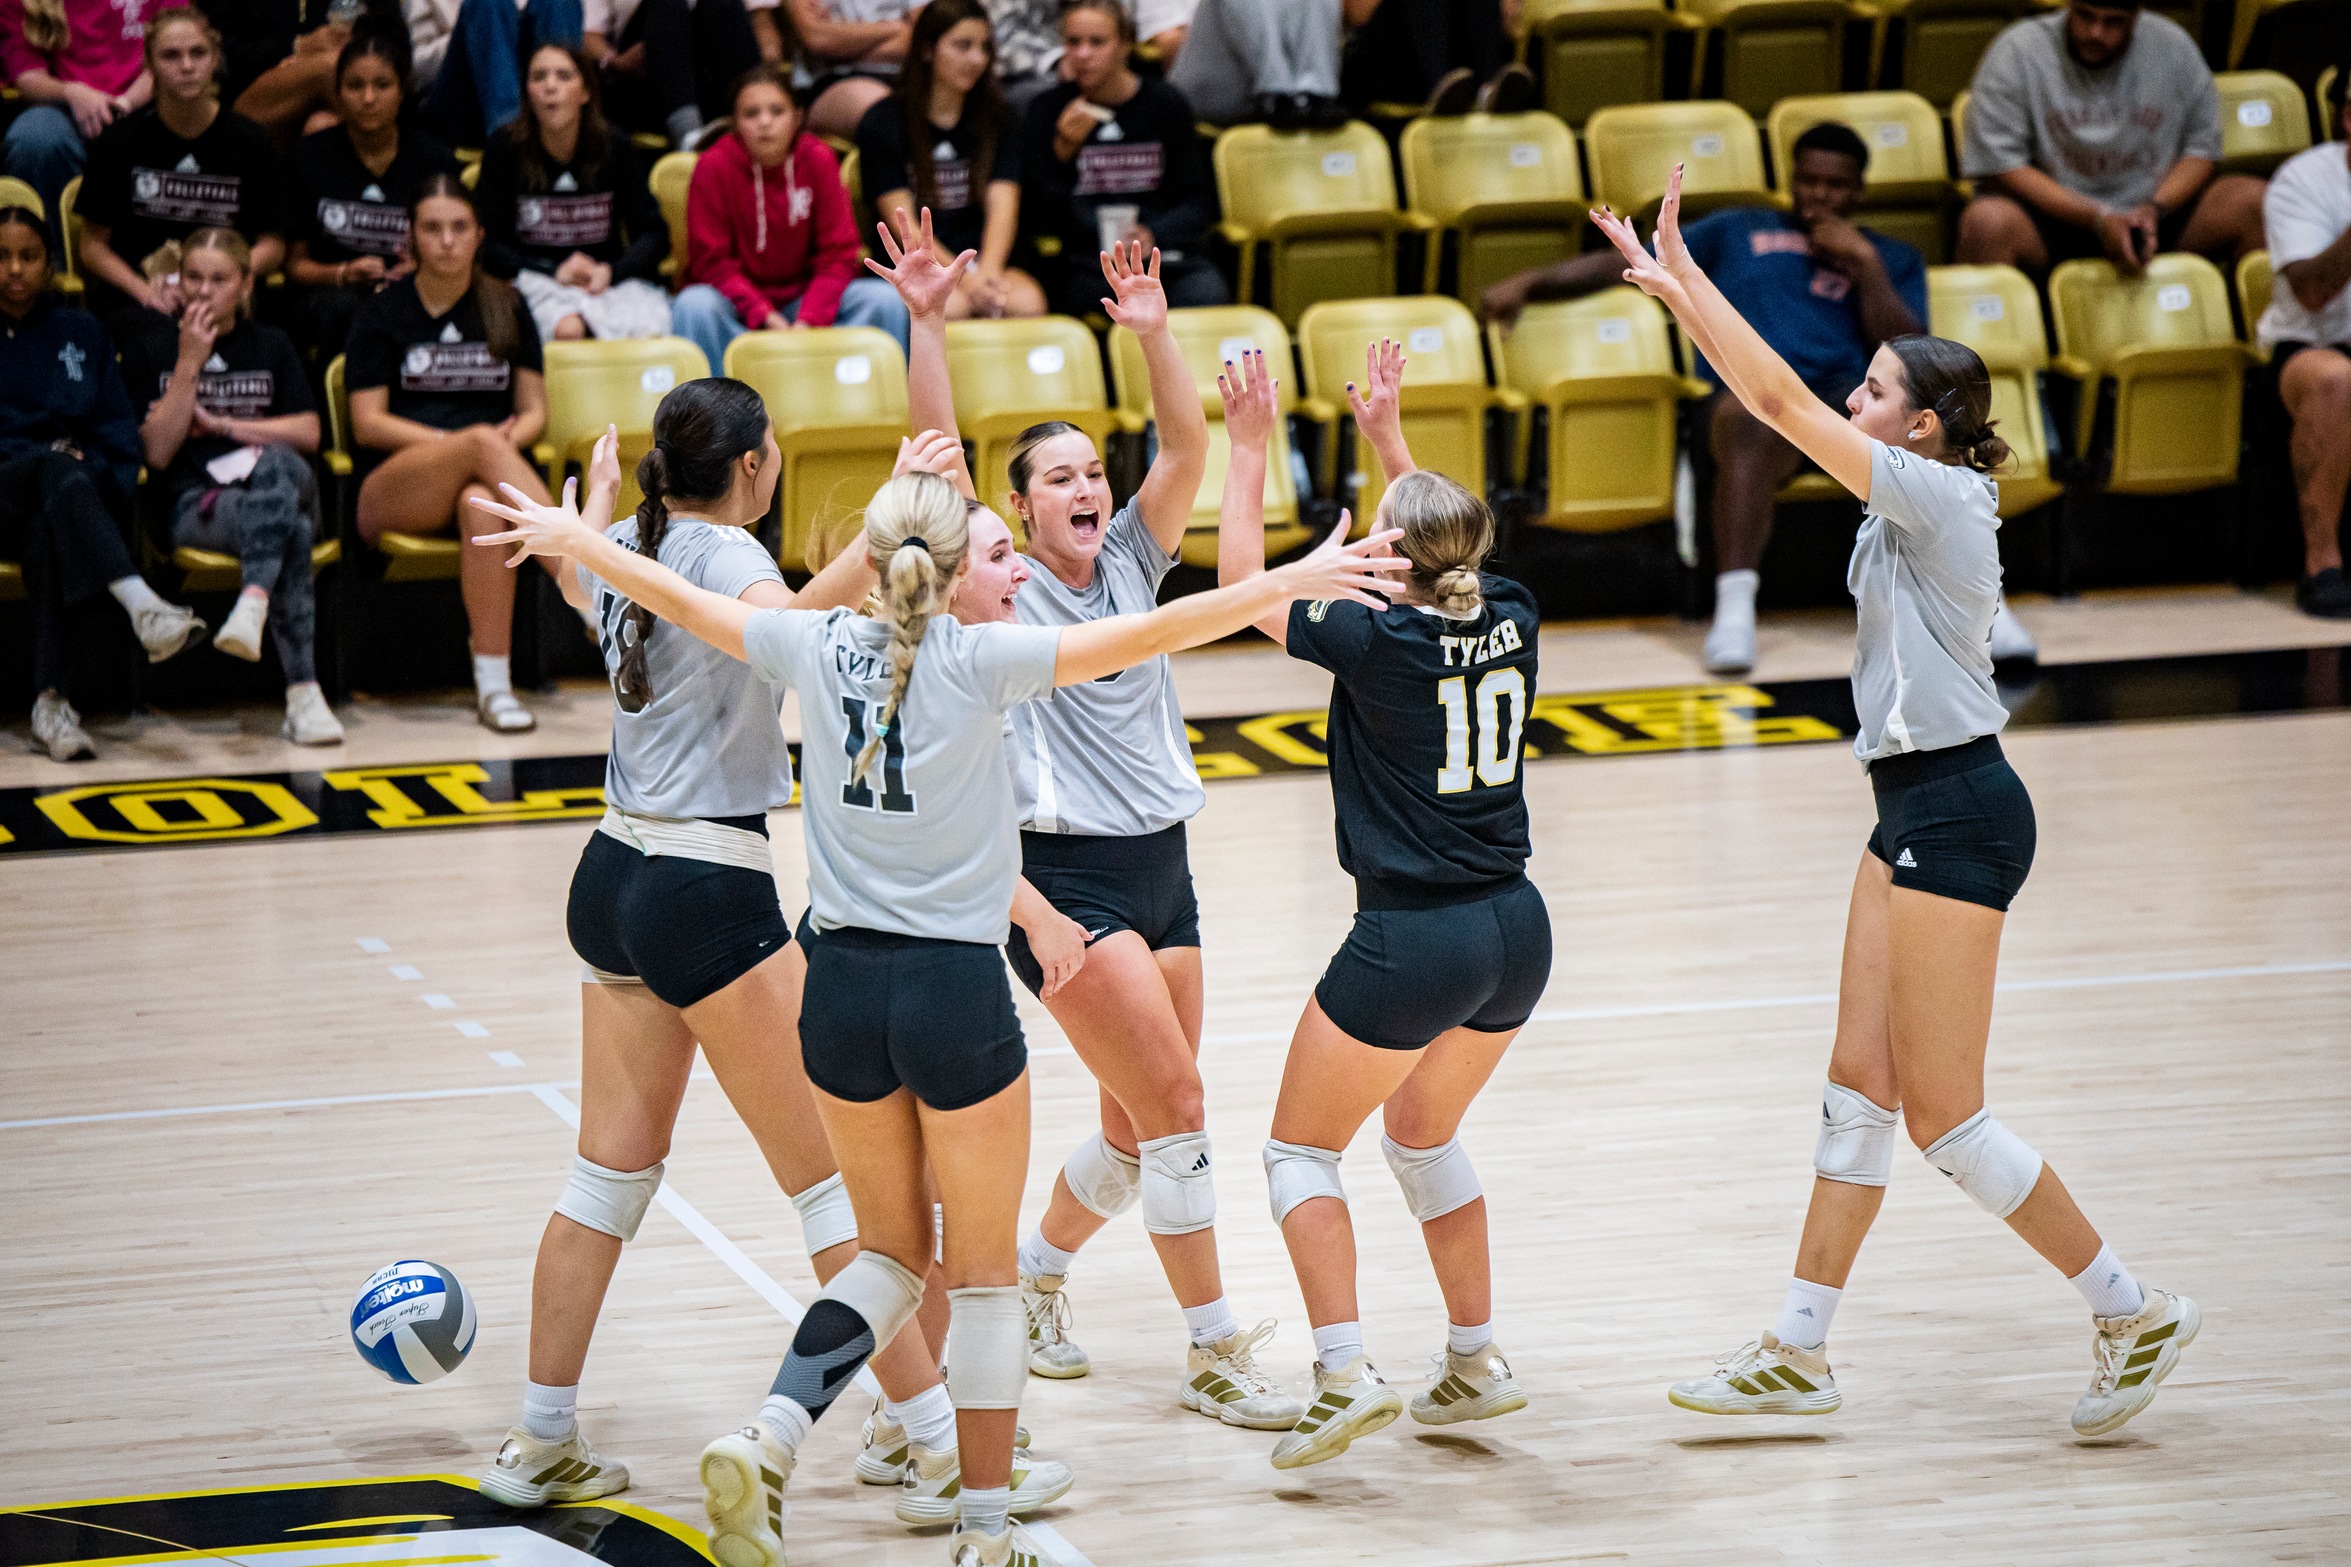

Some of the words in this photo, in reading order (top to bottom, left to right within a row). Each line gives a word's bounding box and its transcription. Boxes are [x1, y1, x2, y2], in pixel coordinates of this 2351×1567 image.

[1440, 619, 1522, 666] TYLER
[836, 644, 895, 681] TYLE
[1438, 667, 1526, 793] 10
[840, 693, 918, 816] 11
[1896, 859, 1918, 868] adidas
[361, 1278, 424, 1318] molten
[400, 1302, 429, 1316] Super
[370, 1315, 396, 1335] Touch
